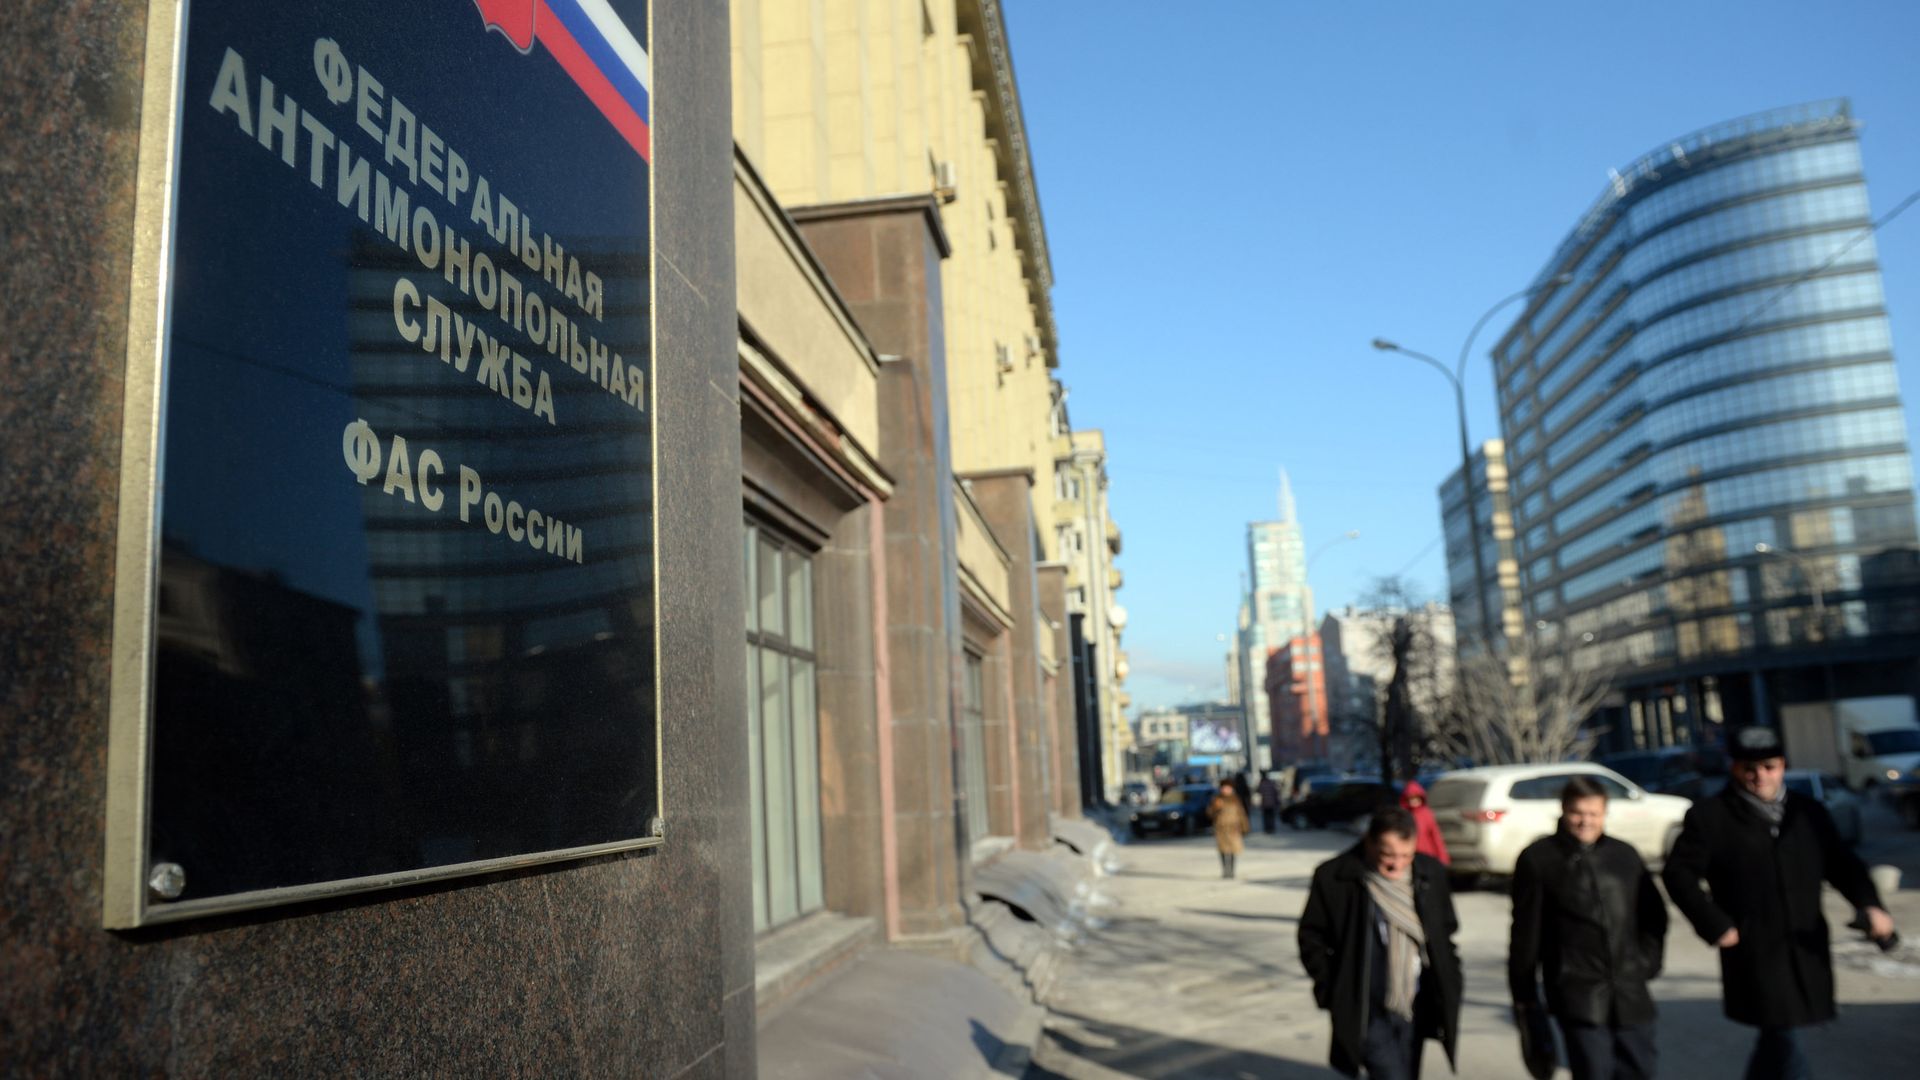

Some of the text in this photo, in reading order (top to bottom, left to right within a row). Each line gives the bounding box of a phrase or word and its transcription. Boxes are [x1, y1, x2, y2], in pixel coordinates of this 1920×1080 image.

[209, 46, 645, 412] АНТИМОНОПОЛЬНАЯ
[313, 37, 603, 322] ФЕДЕРАЛЬНАЯ
[393, 278, 556, 426] СЛУЖБА
[342, 418, 445, 512] ФАС
